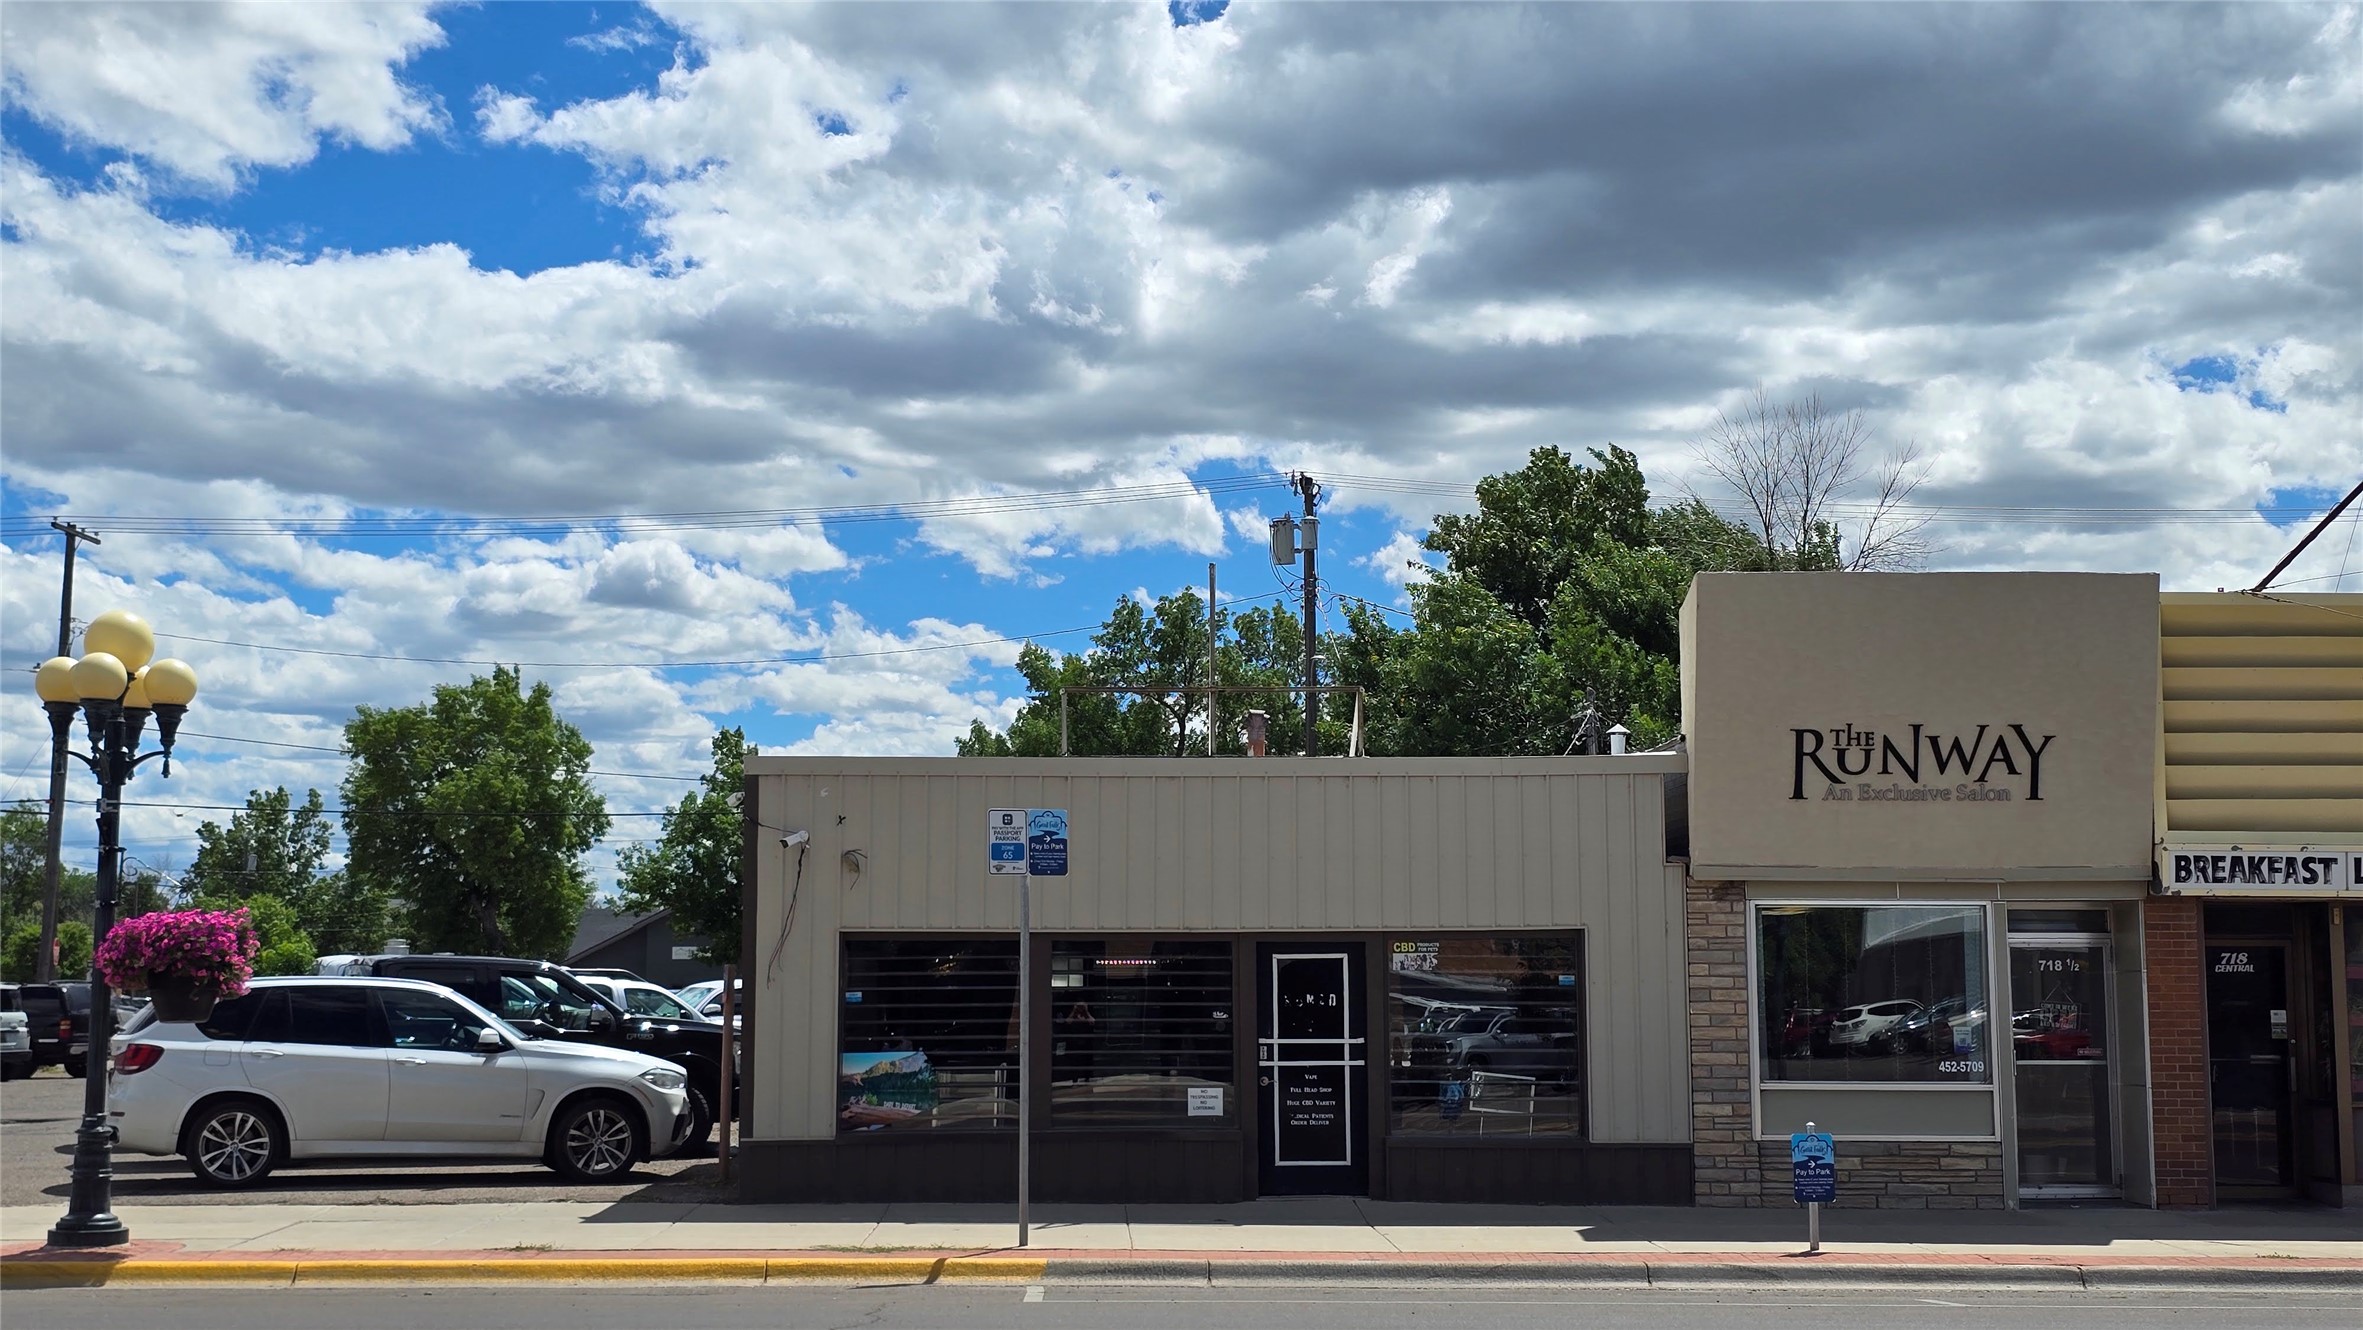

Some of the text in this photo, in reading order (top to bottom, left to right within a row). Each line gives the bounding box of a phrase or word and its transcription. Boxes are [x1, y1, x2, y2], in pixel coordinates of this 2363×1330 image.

[1830, 723, 1875, 747] THE
[1788, 724, 2057, 800] RUNWAY
[1822, 783, 2011, 801] An Exclusive Salon
[1002, 851, 1013, 859] 65
[2174, 855, 2338, 885] BREAKFAST
[1393, 942, 1416, 952] CBD
[2220, 952, 2249, 965] 718
[2038, 959, 2063, 972] 718
[2215, 964, 2255, 973] CENTRAL
[1938, 1061, 1984, 1074] 452-5709
